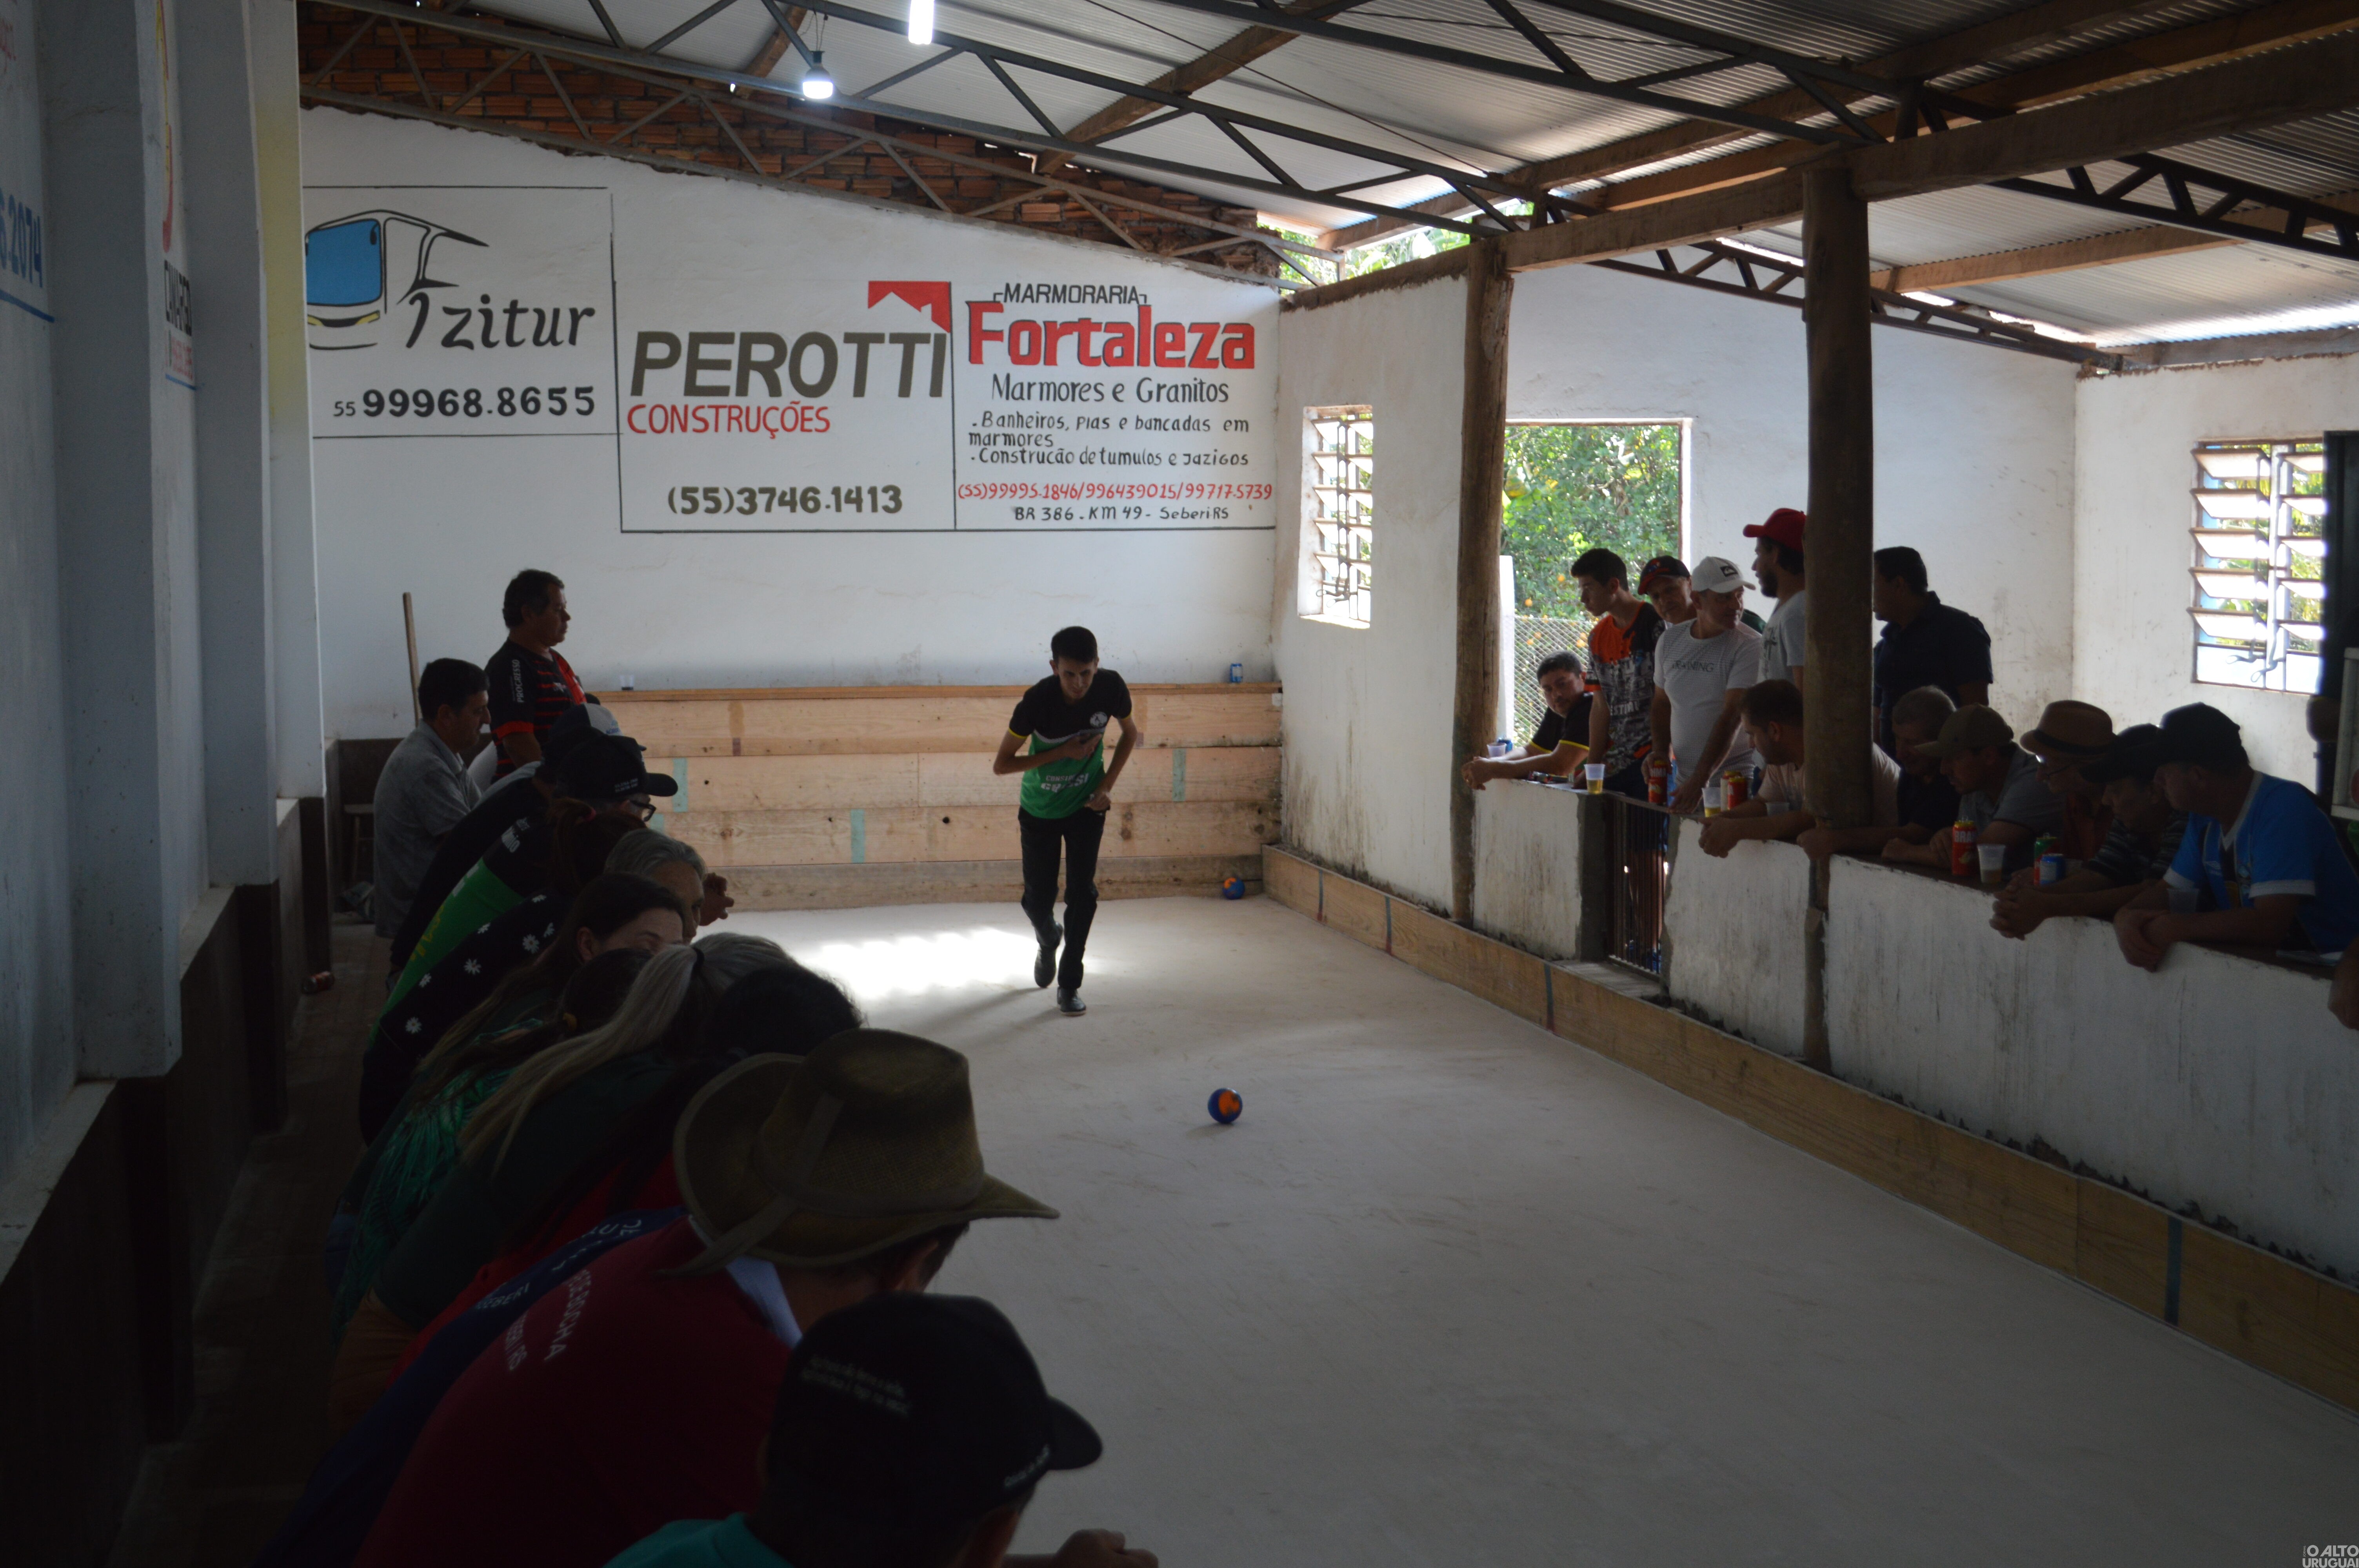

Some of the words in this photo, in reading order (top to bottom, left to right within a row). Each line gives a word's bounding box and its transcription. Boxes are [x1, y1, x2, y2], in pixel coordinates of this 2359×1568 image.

[1003, 283, 1139, 304] MARMORARIA
[966, 301, 1255, 369] Fortaleza
[631, 331, 947, 398] PEROTTI
[333, 401, 356, 417] 55
[363, 386, 595, 417] 99968.8655
[992, 373, 1105, 402] Marmores
[1112, 383, 1125, 402] e
[1136, 377, 1229, 402] Granitos
[627, 401, 831, 439] CONSTRUÇÕES
[1119, 417, 1127, 430] e
[1135, 415, 1211, 432] bancadas
[1223, 419, 1249, 432] em
[969, 432, 1054, 447] marmores
[1080, 445, 1096, 465] de
[1099, 447, 1162, 466] tumulos
[1169, 453, 1177, 465] e
[667, 484, 903, 515] (55)3746.1413
[1014, 507, 1035, 520] BR
[1041, 507, 1074, 521] 386
[1089, 507, 1116, 520] KM
[1123, 506, 1143, 519] 49
